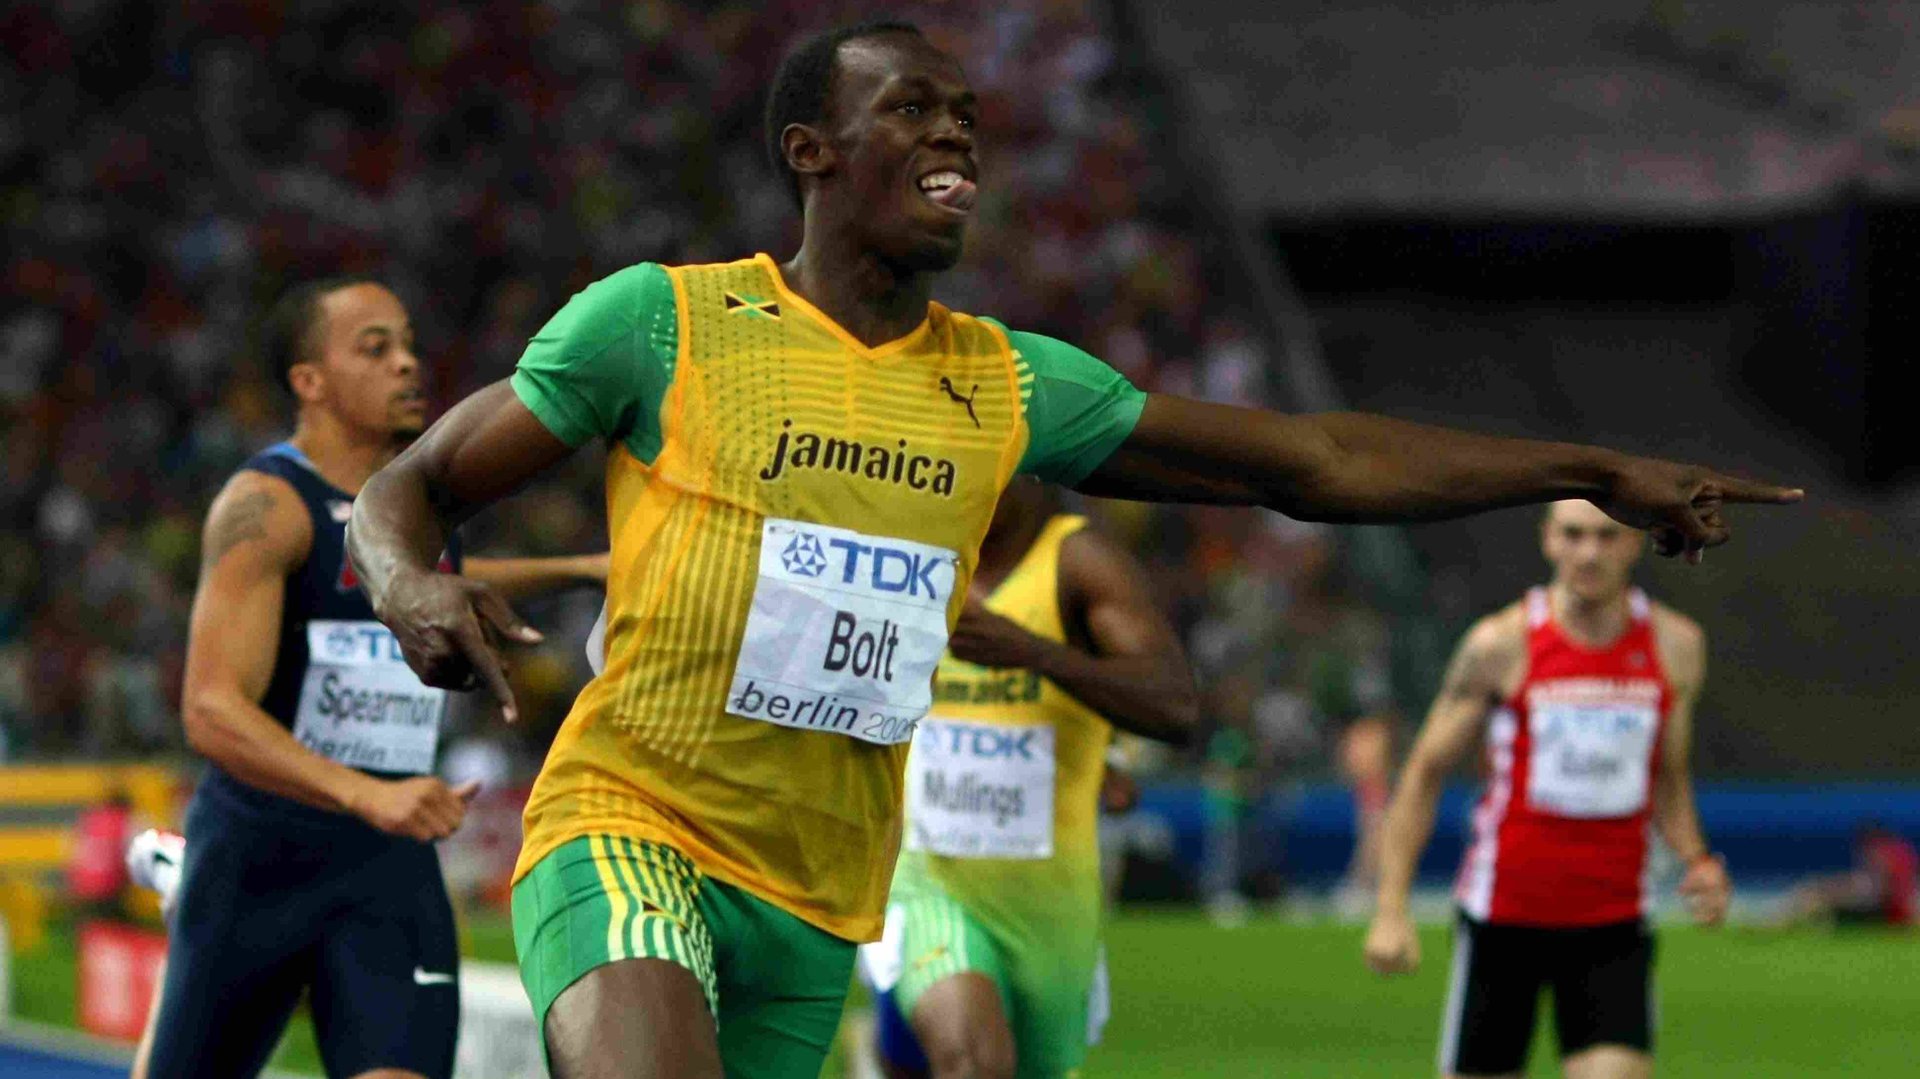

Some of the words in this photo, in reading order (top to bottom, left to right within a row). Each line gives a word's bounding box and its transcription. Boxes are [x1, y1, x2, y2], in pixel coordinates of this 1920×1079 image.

[760, 418, 956, 497] jamaica
[829, 537, 942, 600] TDK
[823, 609, 899, 683] Bolt
[736, 681, 859, 730] berlin
[947, 724, 1037, 760] TDK
